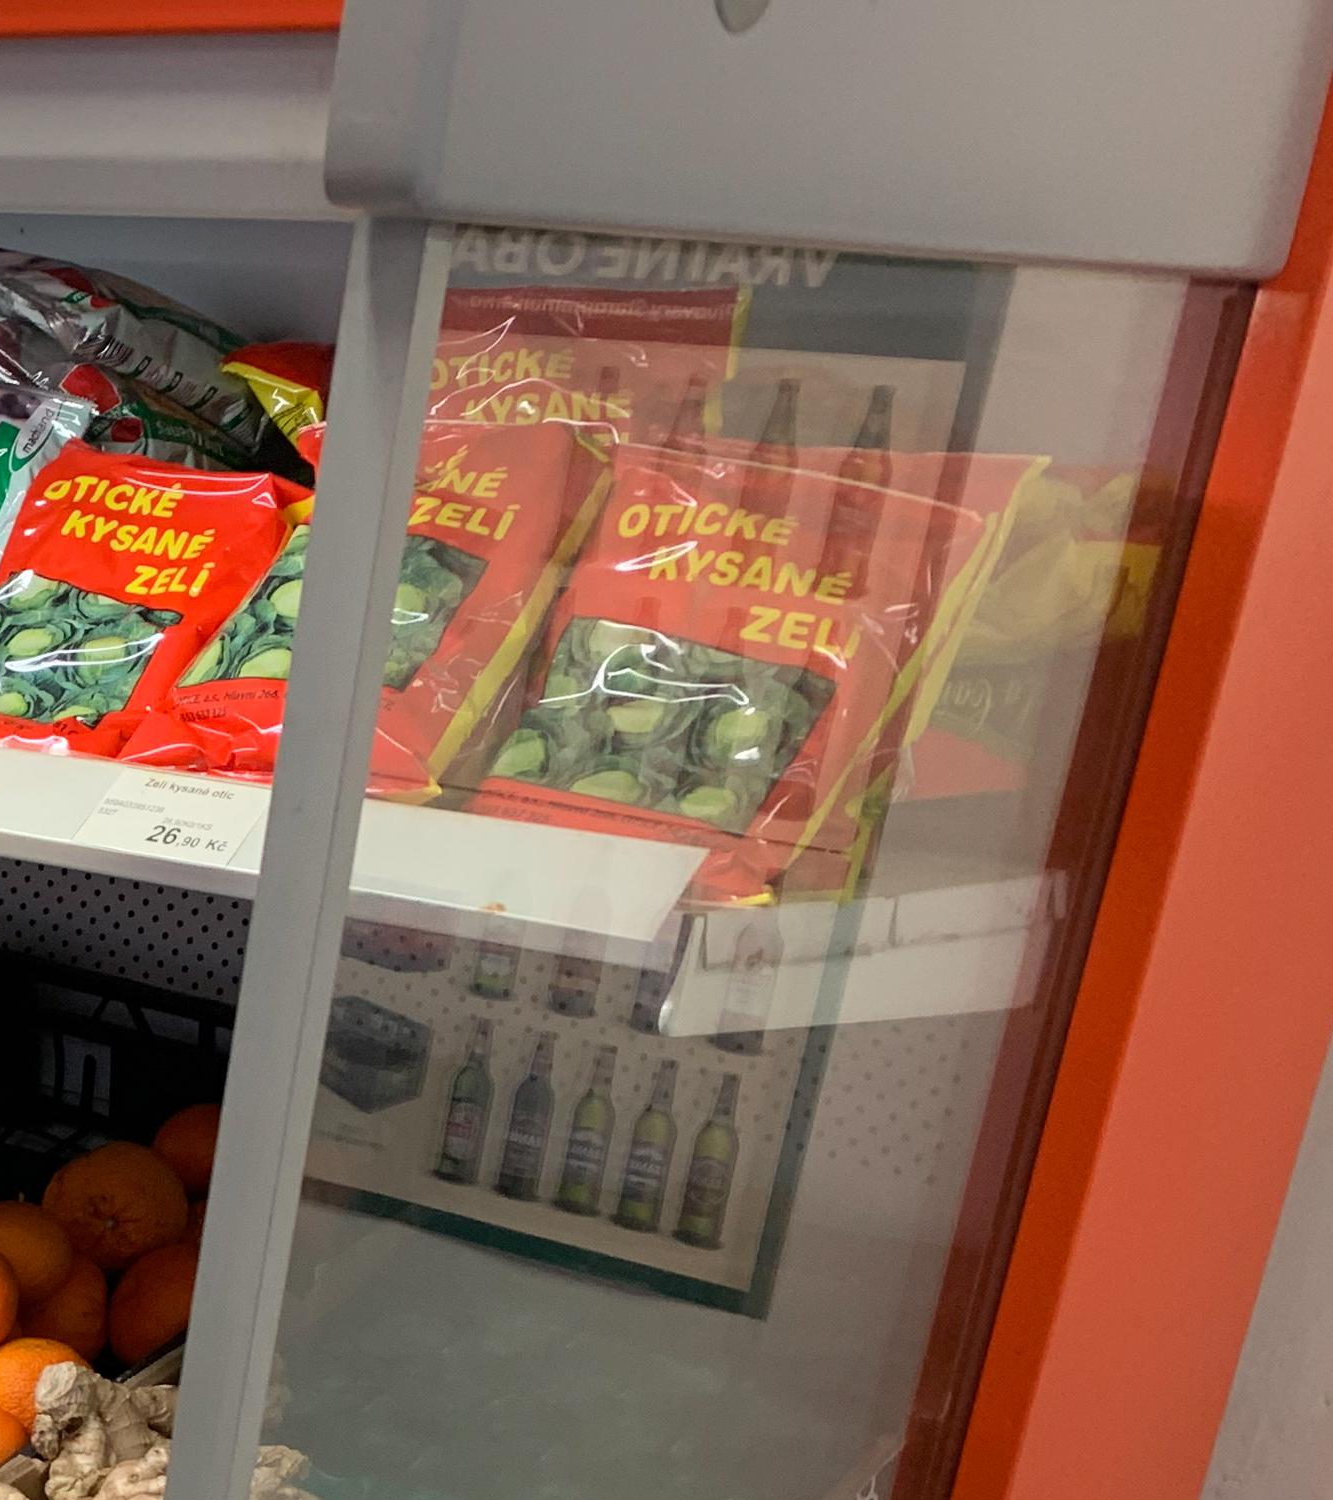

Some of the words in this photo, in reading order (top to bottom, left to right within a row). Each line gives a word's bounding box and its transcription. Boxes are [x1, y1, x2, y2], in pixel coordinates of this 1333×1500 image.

[22, 408, 57, 455] machland
[43, 475, 183, 518] OTICKÉ
[61, 510, 215, 560] KYSANÉ
[407, 497, 520, 540] ZELÍ
[618, 503, 798, 546] OTICKÉ
[125, 562, 215, 597] ZELÍ
[649, 546, 852, 605] KYSANÉ
[740, 606, 863, 660] ZELÍ
[145, 824, 200, 848] 26,90
[205, 839, 228, 852] Kč
